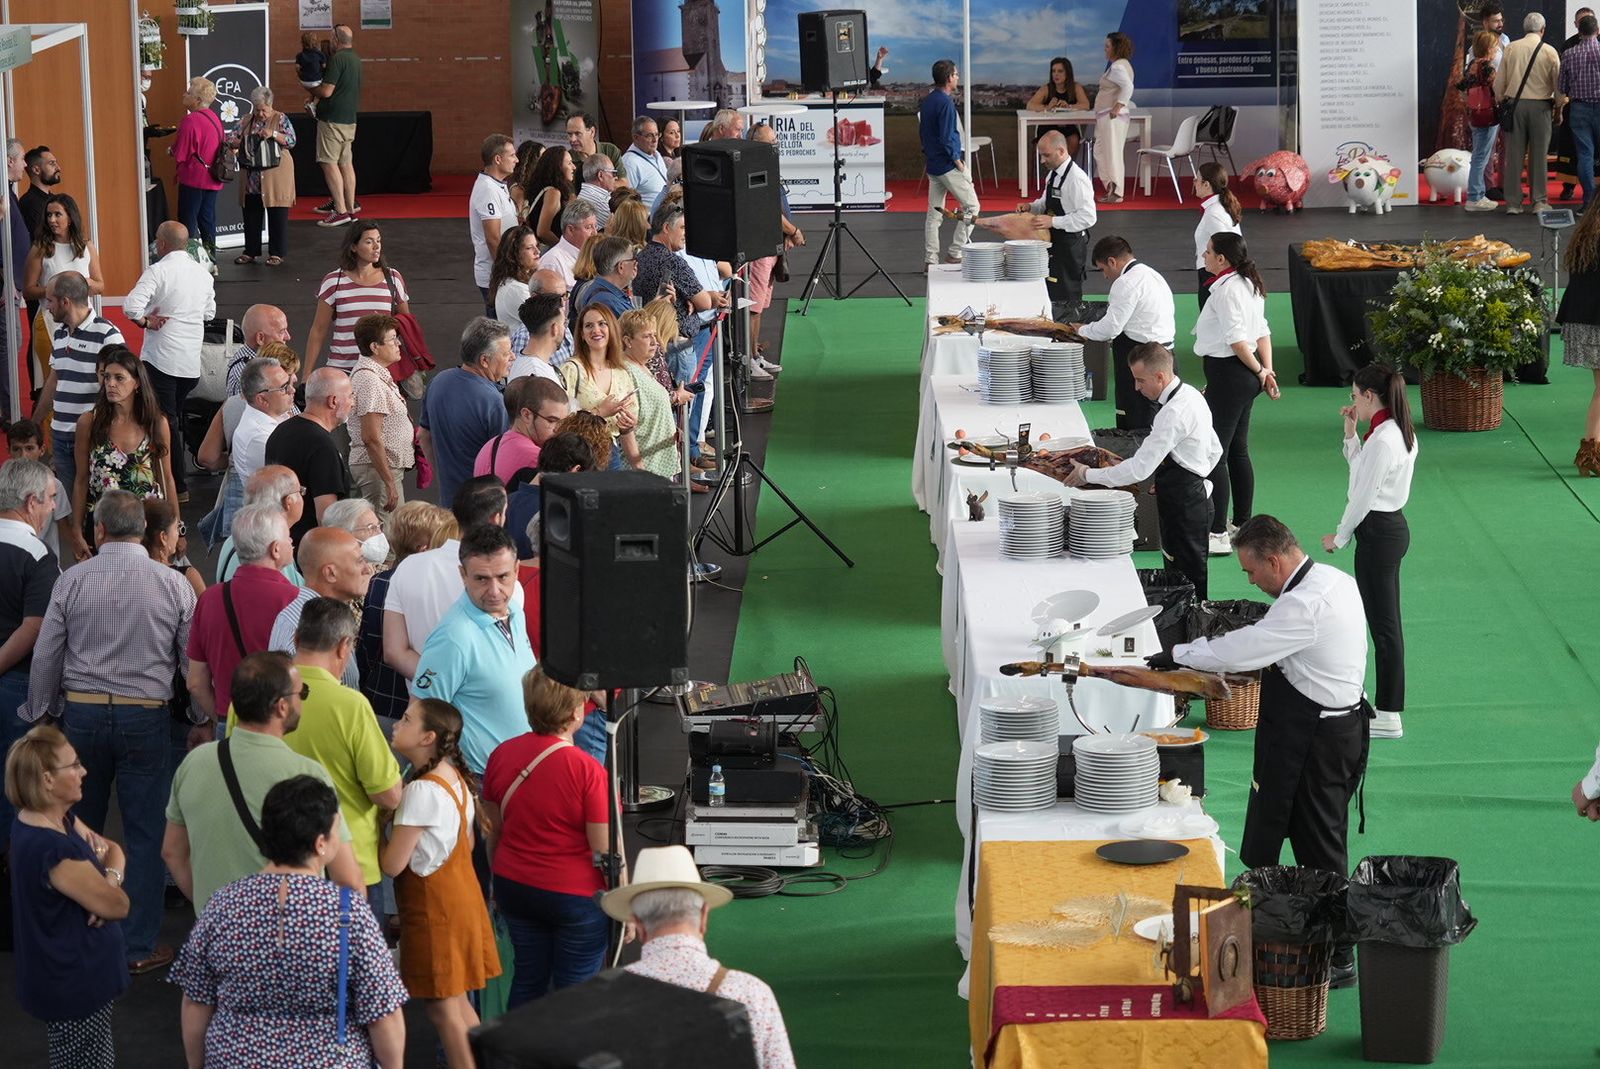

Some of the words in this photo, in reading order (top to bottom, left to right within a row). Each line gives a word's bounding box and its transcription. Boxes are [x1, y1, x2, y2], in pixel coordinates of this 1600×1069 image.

[1178, 56, 1192, 64] Entre
[1219, 56, 1242, 65] paredes
[1242, 55, 1251, 63] de
[800, 122, 814, 131] DEL
[790, 131, 815, 141] IBÉRICO
[786, 149, 817, 157] PEDROCHES
[488, 203, 495, 215] 9
